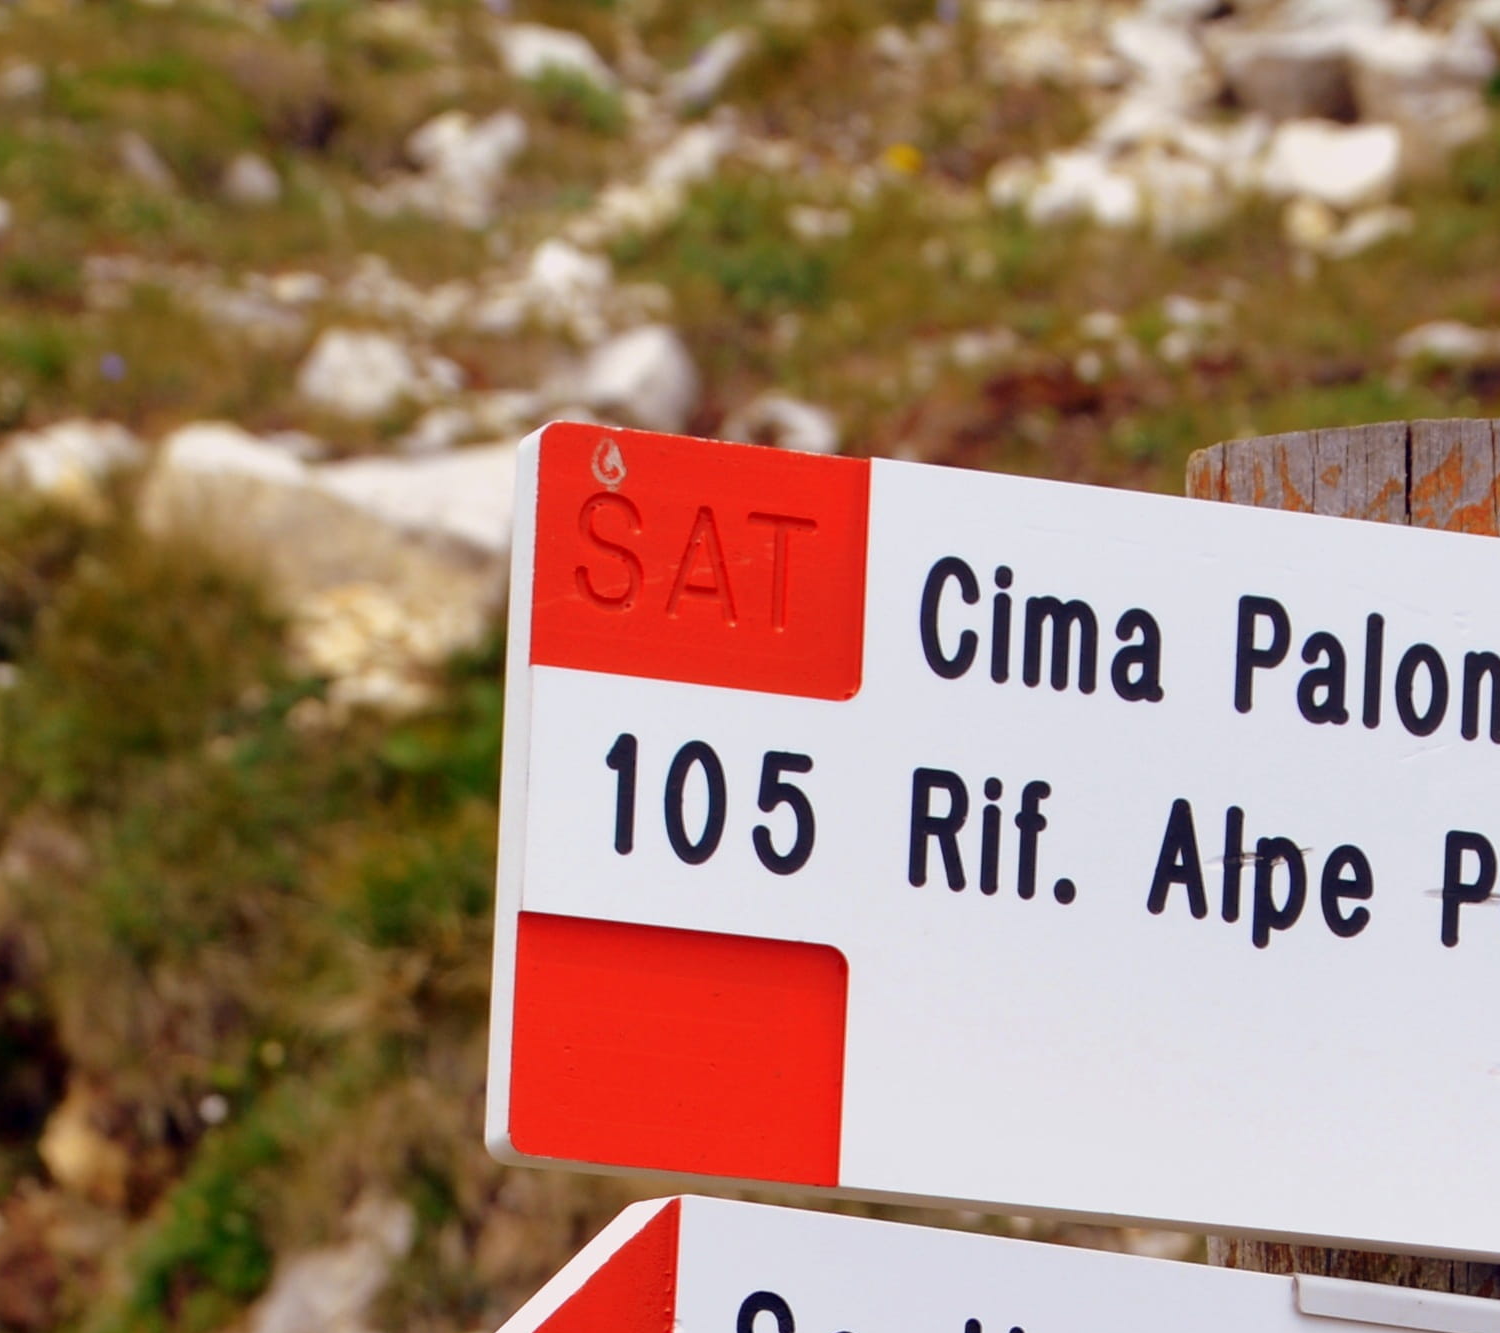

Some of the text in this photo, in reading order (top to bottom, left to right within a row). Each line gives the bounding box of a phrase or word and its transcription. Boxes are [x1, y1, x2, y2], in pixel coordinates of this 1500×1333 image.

[573, 490, 820, 632] SAT
[919, 555, 1165, 704] Cima
[605, 732, 816, 877] 105
[907, 766, 1077, 906] Rif.
[1145, 797, 1375, 950] Alpe
